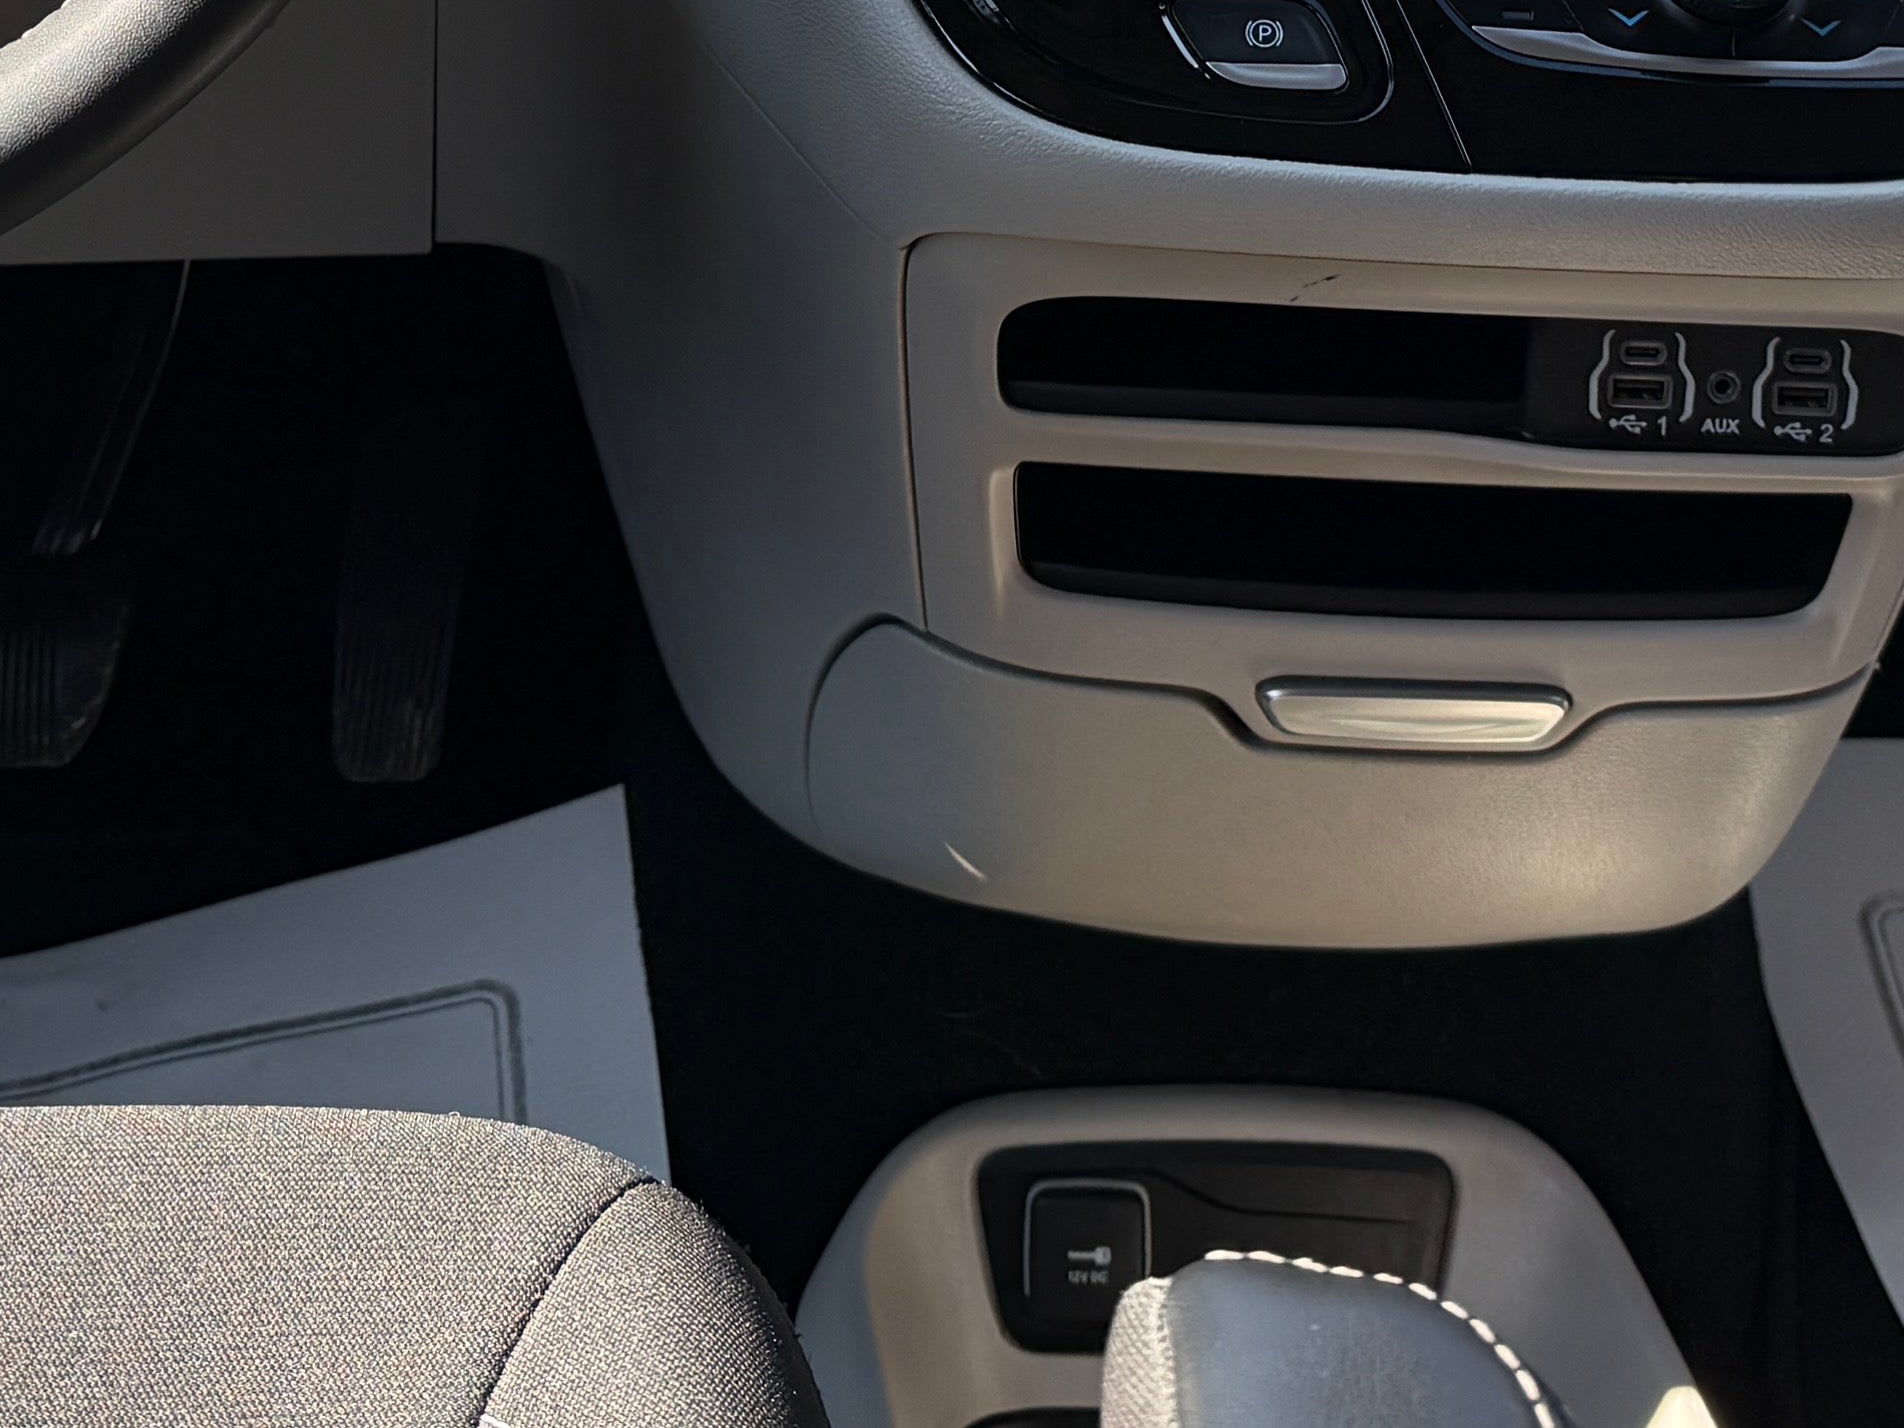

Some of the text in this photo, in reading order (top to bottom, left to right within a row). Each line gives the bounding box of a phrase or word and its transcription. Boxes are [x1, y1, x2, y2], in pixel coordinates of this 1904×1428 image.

[1656, 417, 1667, 436] 1
[1701, 418, 1741, 435] AUX
[1819, 425, 1834, 443] 2
